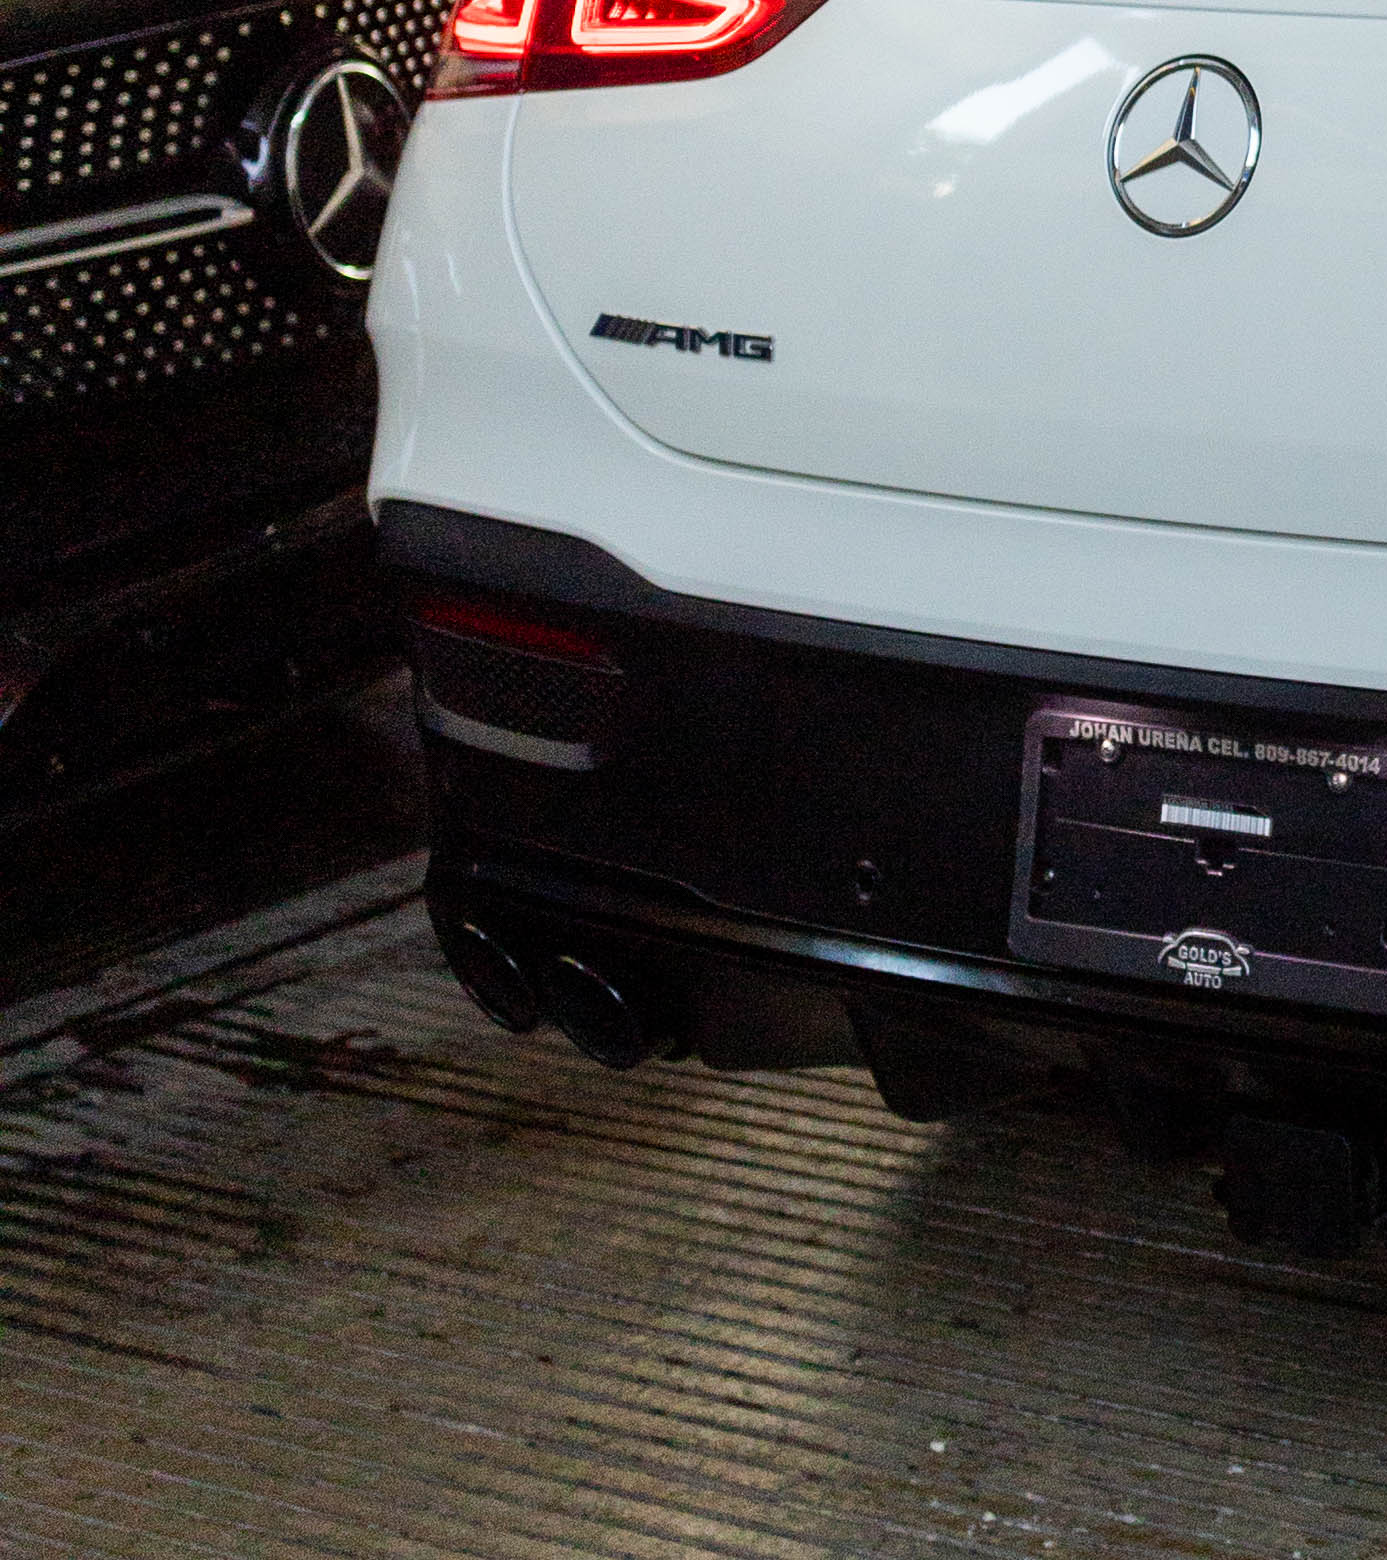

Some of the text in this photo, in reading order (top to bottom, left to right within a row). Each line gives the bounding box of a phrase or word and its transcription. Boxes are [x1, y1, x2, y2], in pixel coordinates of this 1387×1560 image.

[640, 320, 775, 363] AMG
[1069, 721, 1133, 745] JOHAN
[1207, 737, 1249, 758] CEL.
[1178, 944, 1233, 966] GOLD'S
[1183, 971, 1222, 989] AUTO
